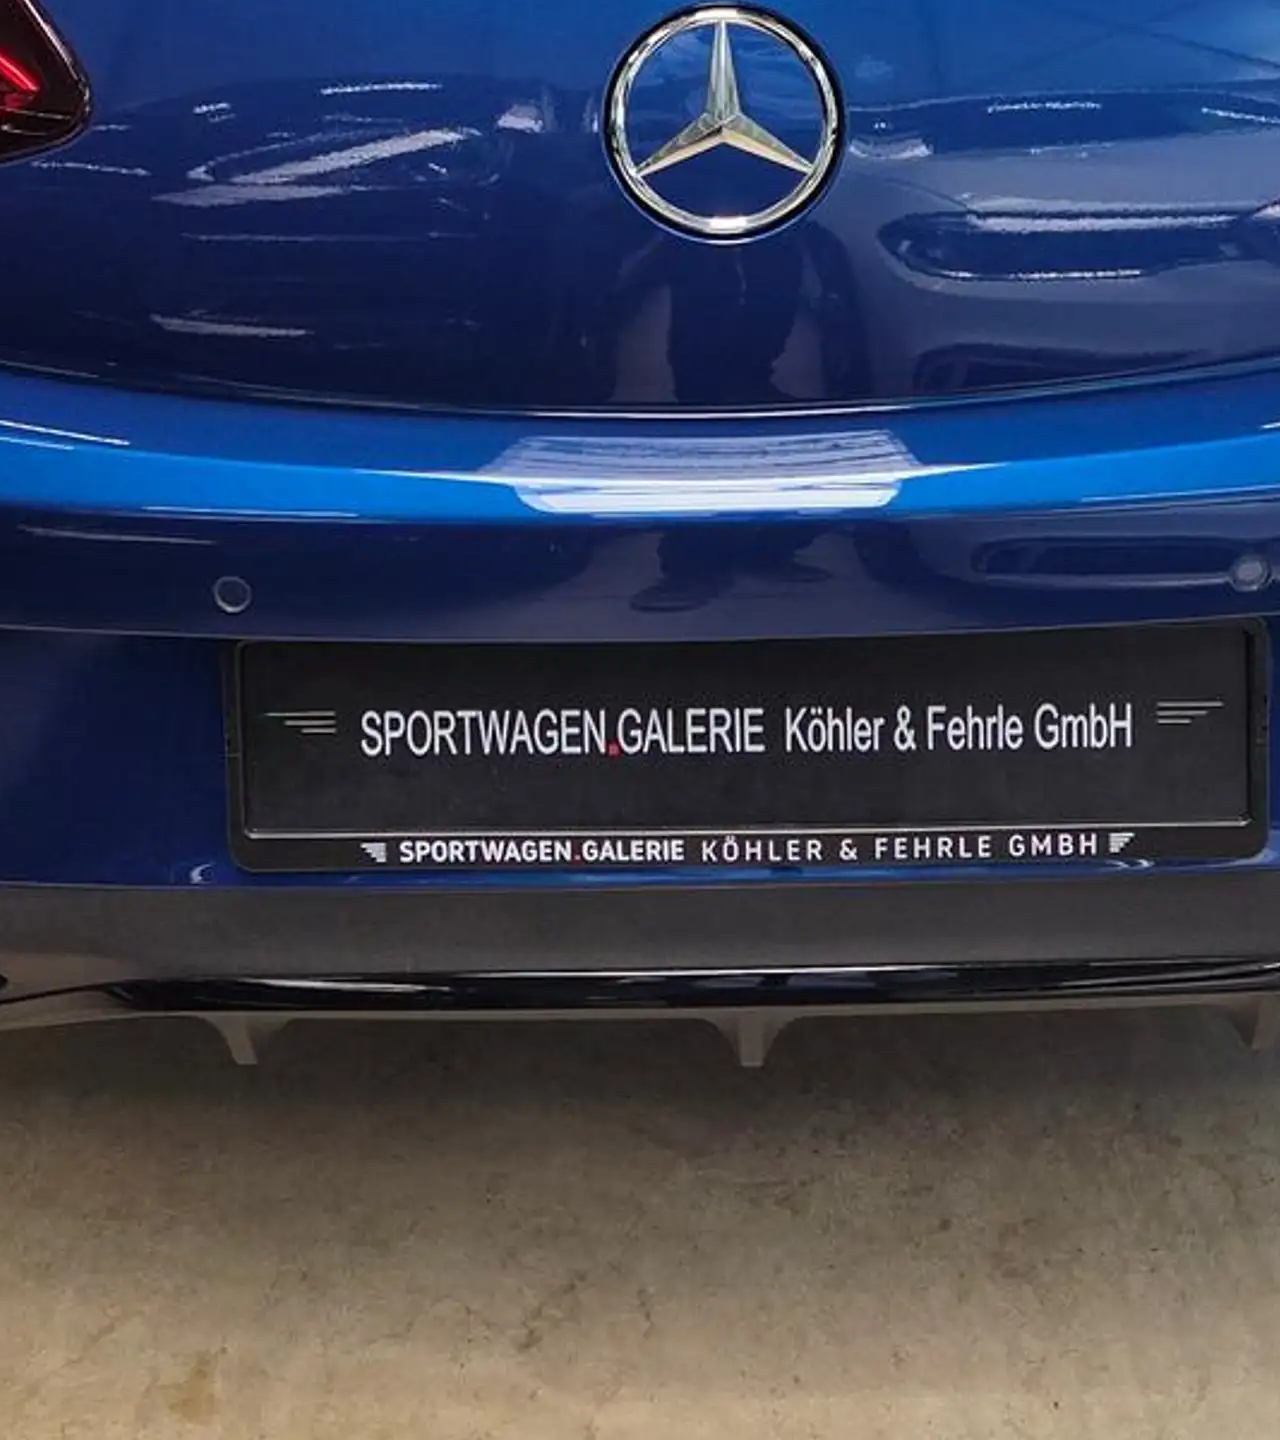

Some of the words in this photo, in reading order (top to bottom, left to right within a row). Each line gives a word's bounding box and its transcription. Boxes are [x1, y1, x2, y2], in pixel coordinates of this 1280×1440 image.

[785, 707, 884, 752] Köhler
[894, 706, 917, 751] &
[927, 704, 1022, 750] Fehrle
[1034, 702, 1133, 749] GmbH
[702, 836, 823, 863] KÖHLER
[839, 839, 858, 860] &
[875, 835, 992, 859] FEHRLE
[1008, 832, 1098, 857] GMBH
